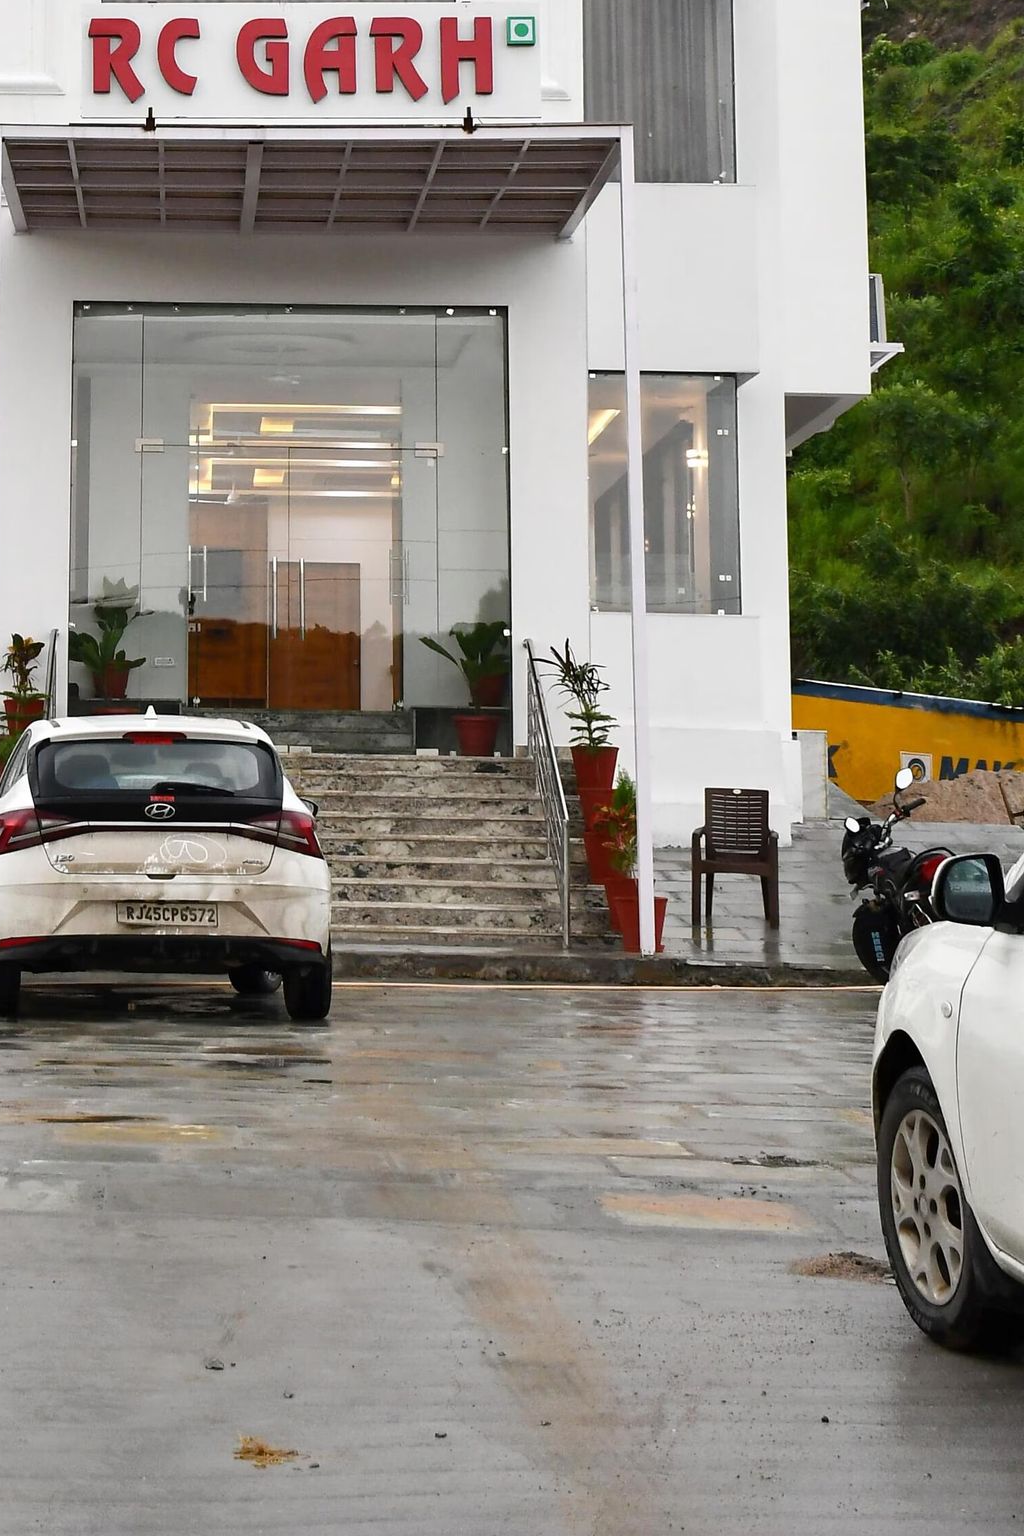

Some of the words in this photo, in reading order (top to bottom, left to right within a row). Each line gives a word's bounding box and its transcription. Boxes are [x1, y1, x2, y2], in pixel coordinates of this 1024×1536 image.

[88, 17, 200, 103] RC
[236, 16, 493, 104] GARH
[126, 905, 216, 923] RJ45CP6572
